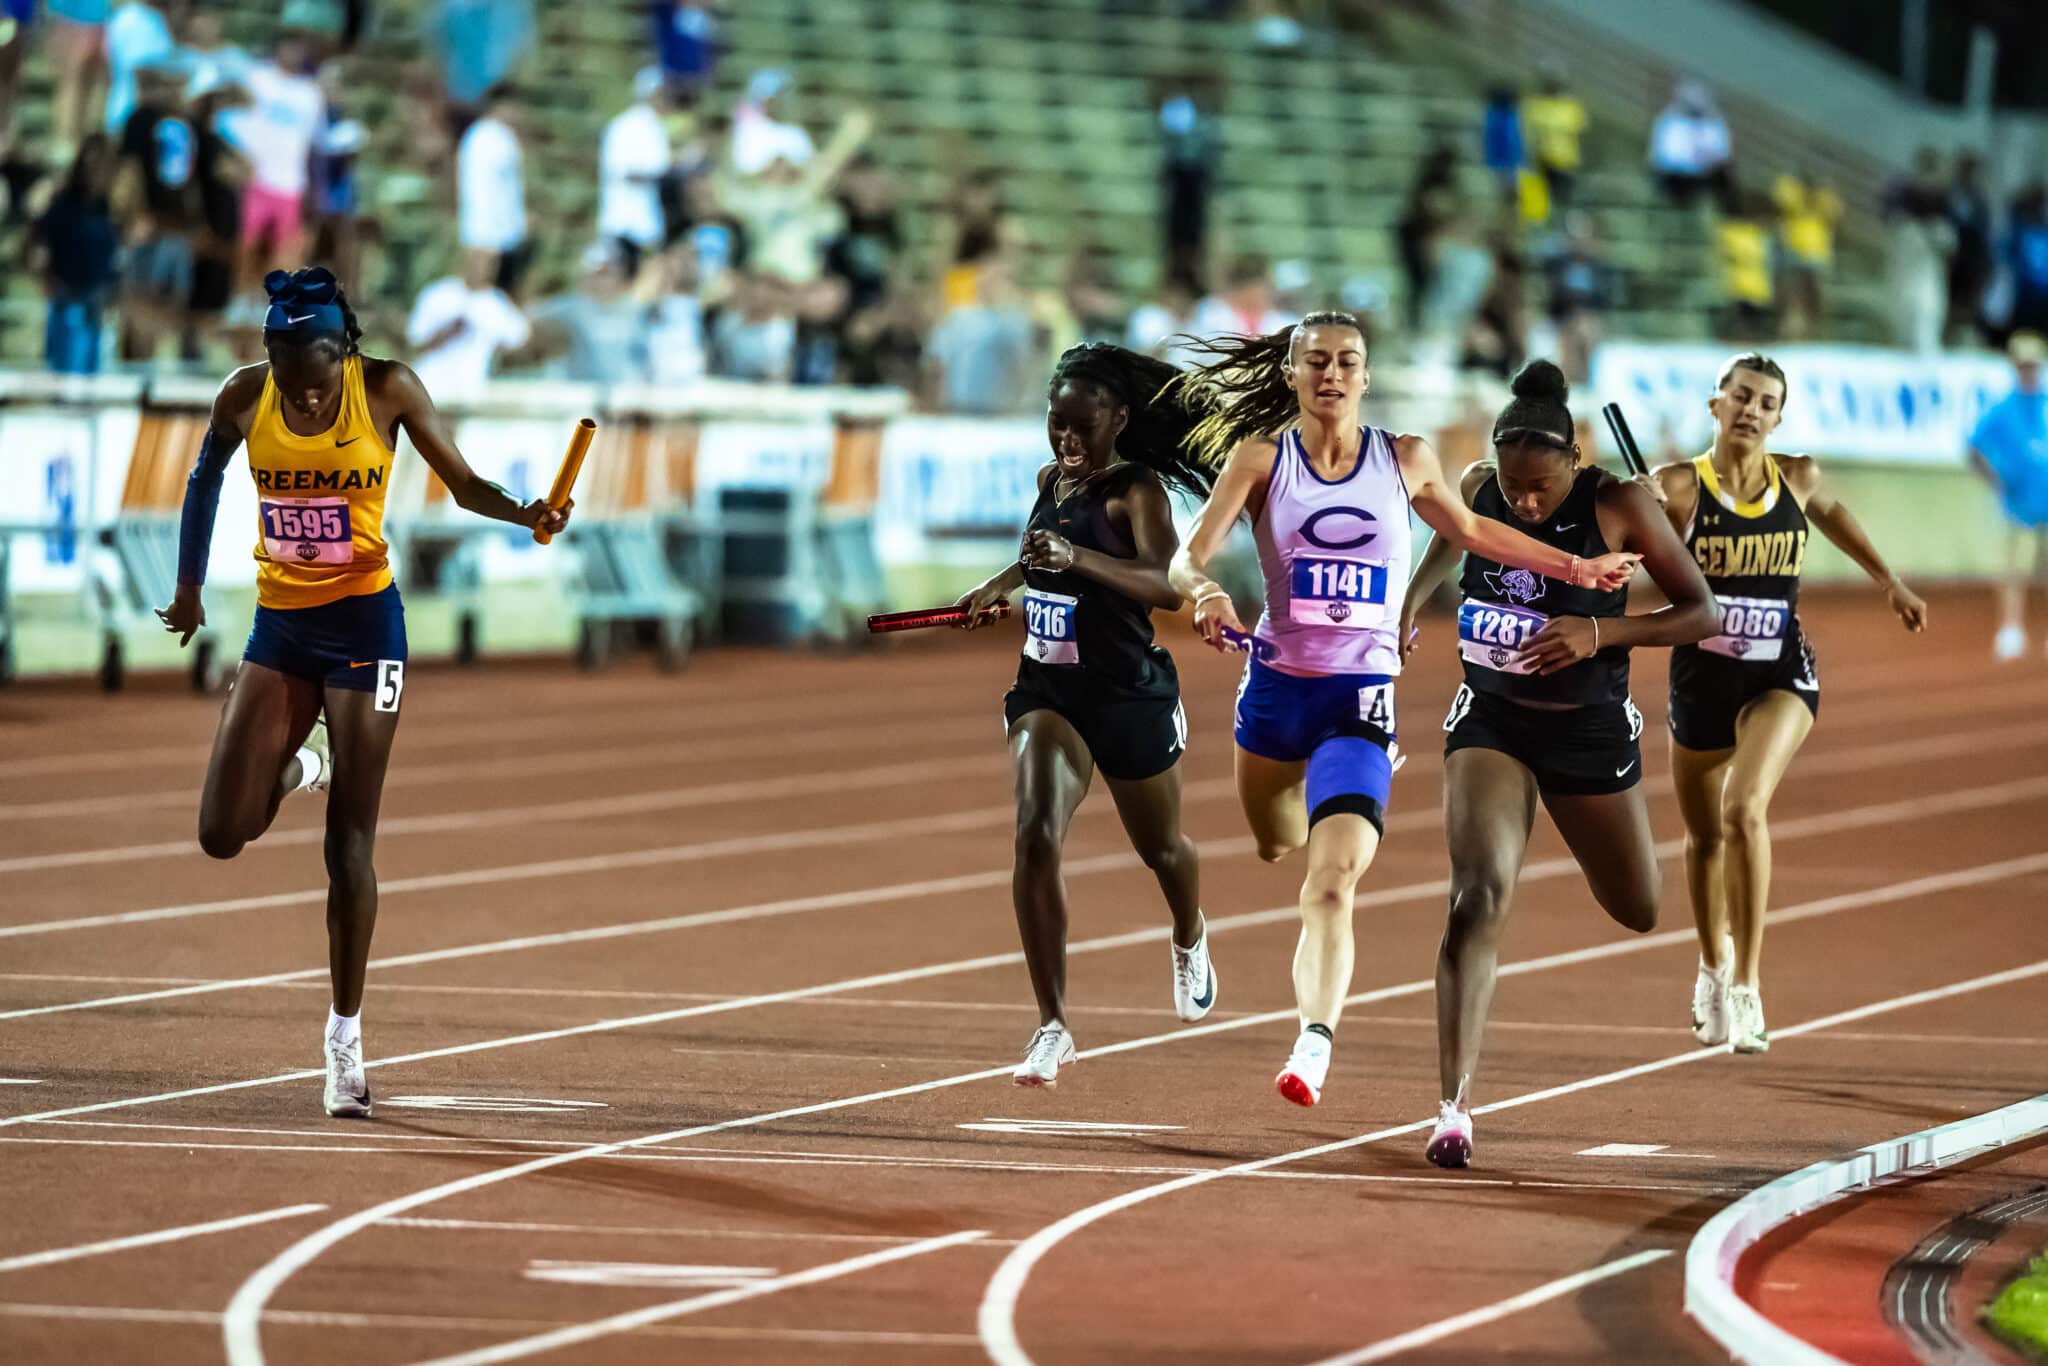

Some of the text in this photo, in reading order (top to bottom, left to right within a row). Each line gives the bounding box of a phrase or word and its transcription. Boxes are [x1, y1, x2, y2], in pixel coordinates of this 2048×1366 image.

[267, 507, 342, 539] 1595
[1298, 506, 1378, 550] C
[1308, 562, 1372, 598] 1141
[1472, 609, 1534, 650] 1281
[382, 663, 399, 709] 5
[1368, 688, 1389, 730] 4
